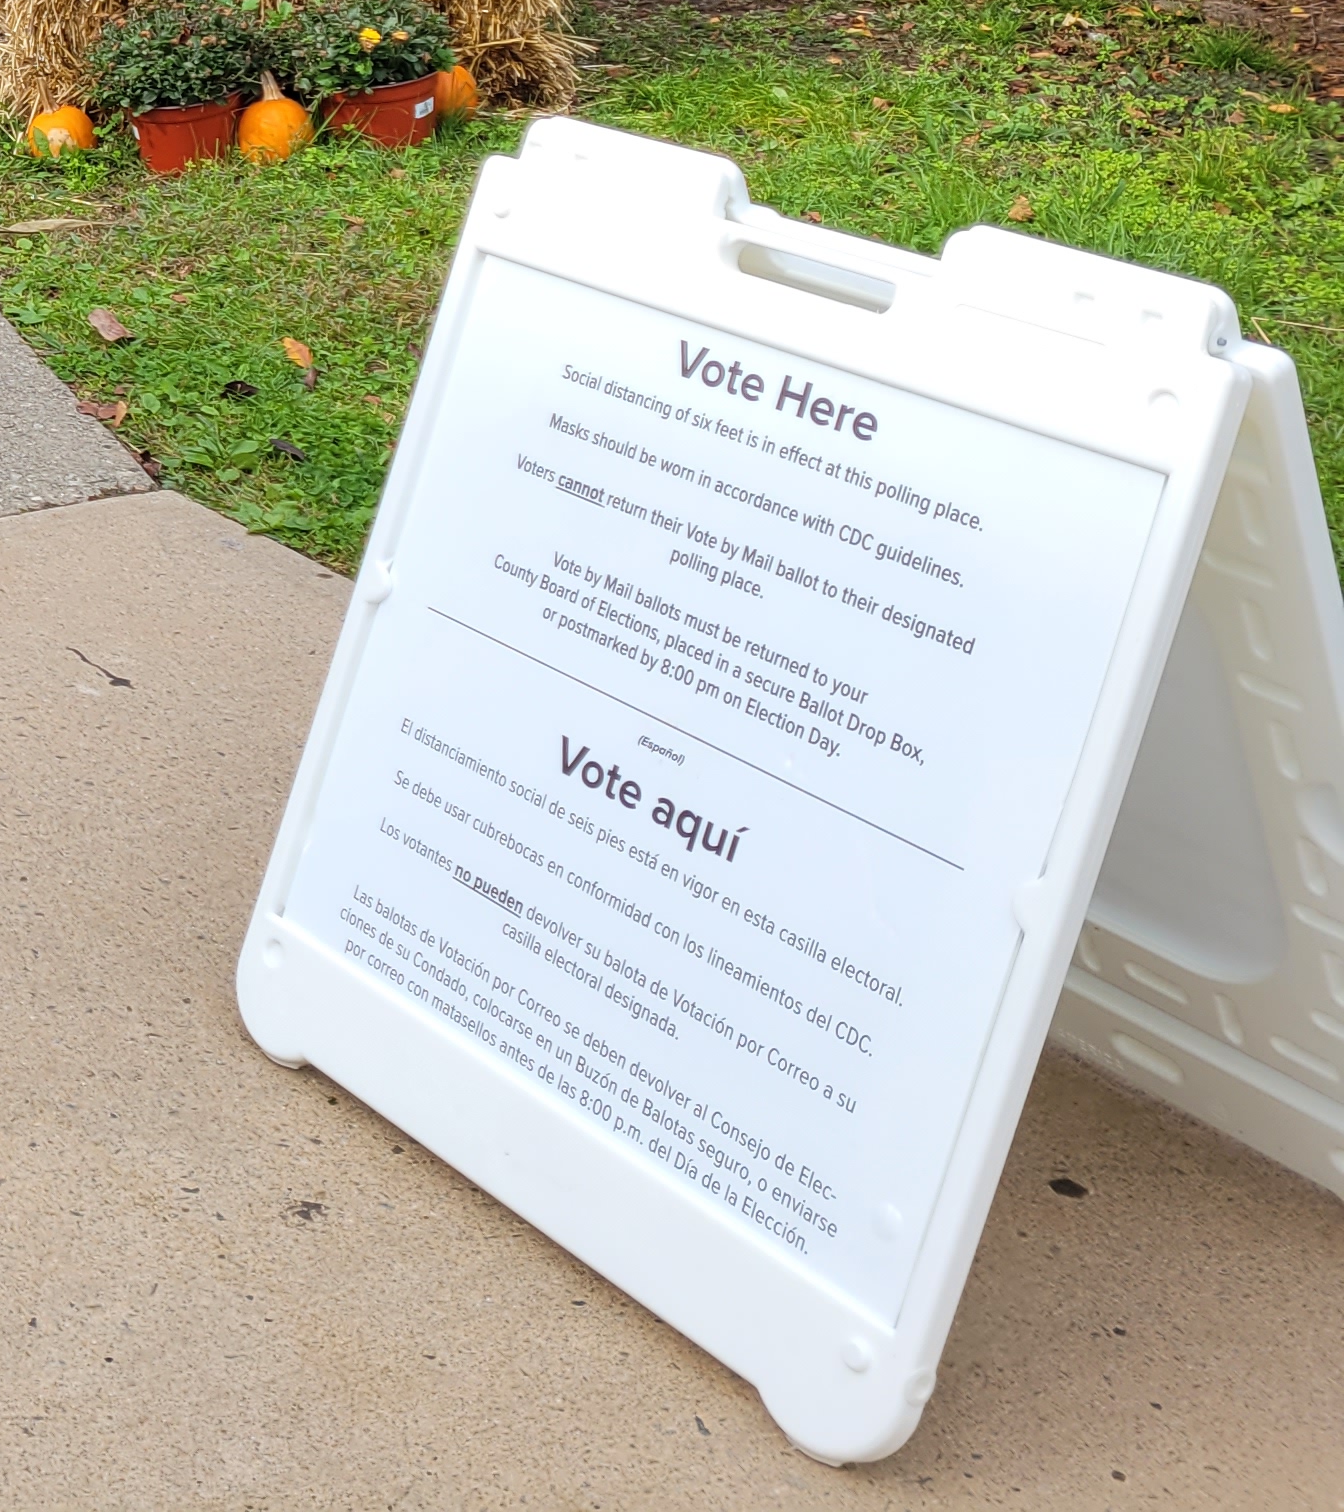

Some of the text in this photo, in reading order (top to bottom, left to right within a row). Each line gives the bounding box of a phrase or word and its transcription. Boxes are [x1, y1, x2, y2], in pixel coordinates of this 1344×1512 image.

[561, 364, 983, 532] Social distancing of six feet is in effect at this polling place.
[680, 339, 879, 442] Vote Here
[517, 453, 976, 656] Voters cannot return their Vote by Mail ballot to their designated
[548, 412, 964, 588] Masks should be worn in accordance with CDC guidelines.
[668, 548, 764, 599] polling place.
[494, 553, 925, 767] County Board of Elections, placed in a secure Ballot Drop Box,
[542, 607, 841, 758] or postmarked by 8:00 pm on Election Day.
[553, 550, 870, 705] Vote by Mail ballots must be returned to your
[561, 734, 751, 863] Vote aquí
[637, 734, 686, 767] (Español)
[400, 717, 903, 1007] El distanciamiento social de seis pies está en vigor en esta casilla electoral.
[379, 816, 857, 1114] Los votantes no pueden devolver su balota de Votación por Correo a su
[502, 923, 679, 1041] casilla electoral designada.
[344, 939, 808, 1255] por correo con matasellos antes de las 8:00 p.m. del Día de la Elección.
